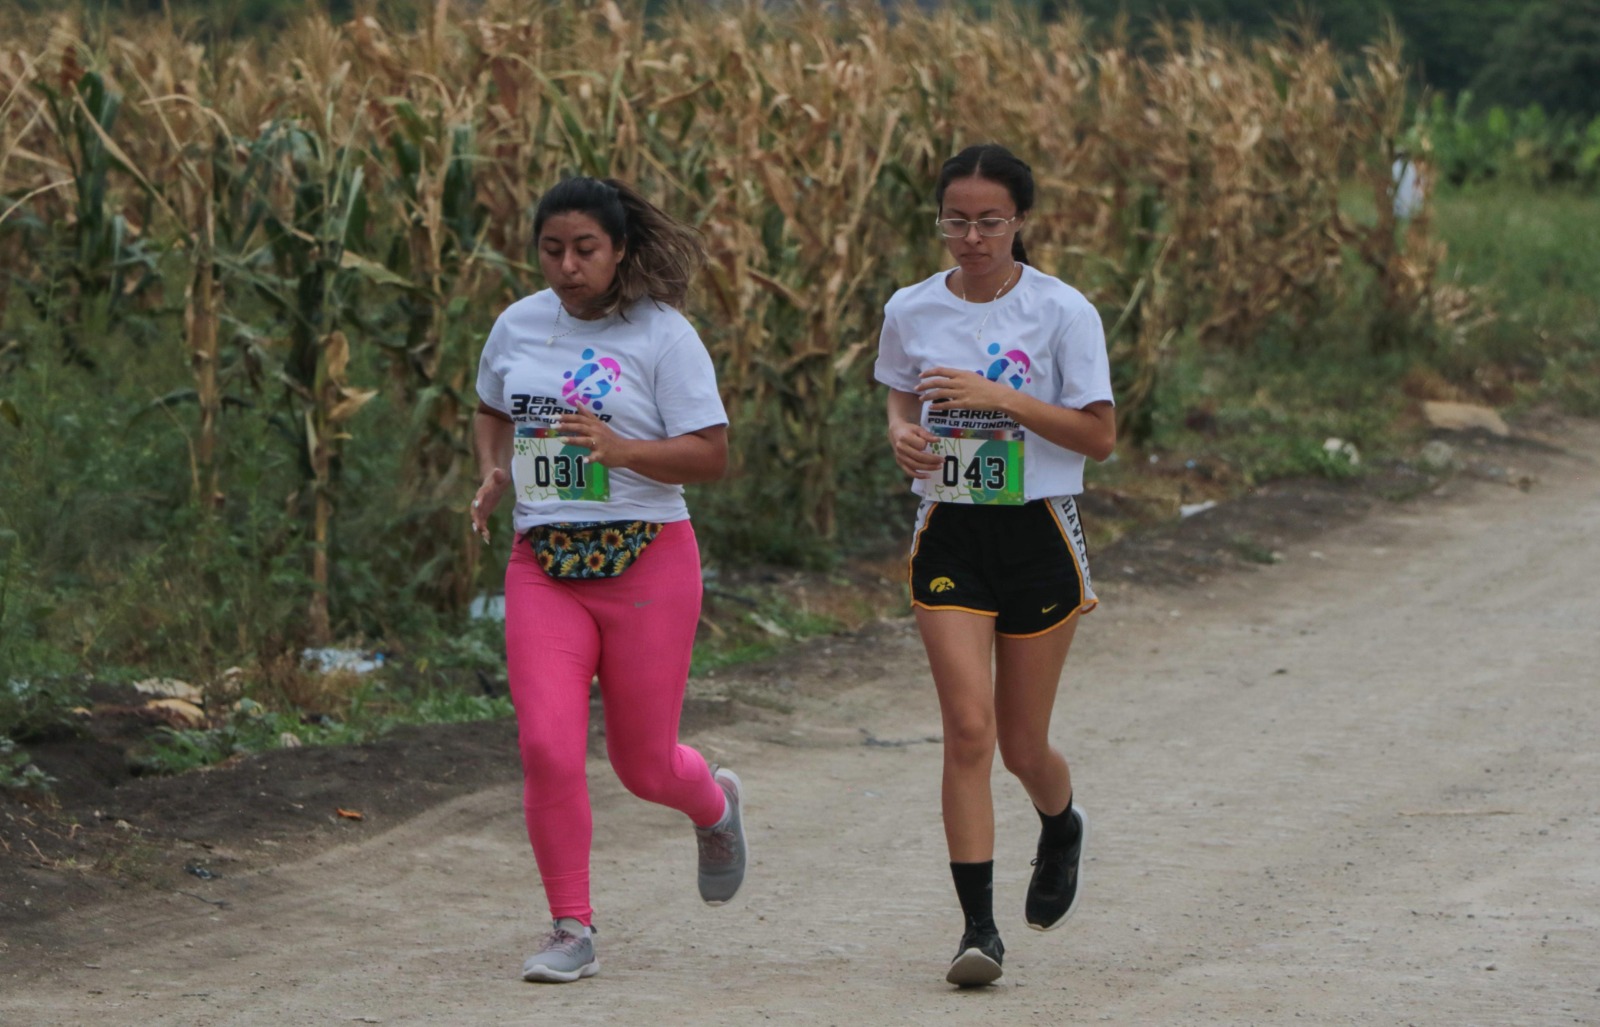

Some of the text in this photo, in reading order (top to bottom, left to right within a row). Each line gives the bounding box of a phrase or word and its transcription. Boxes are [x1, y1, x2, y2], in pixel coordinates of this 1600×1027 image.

[529, 406, 612, 422] CARRA
[949, 409, 1010, 420] CARRE
[534, 455, 586, 488] 031
[942, 455, 1006, 490] 043
